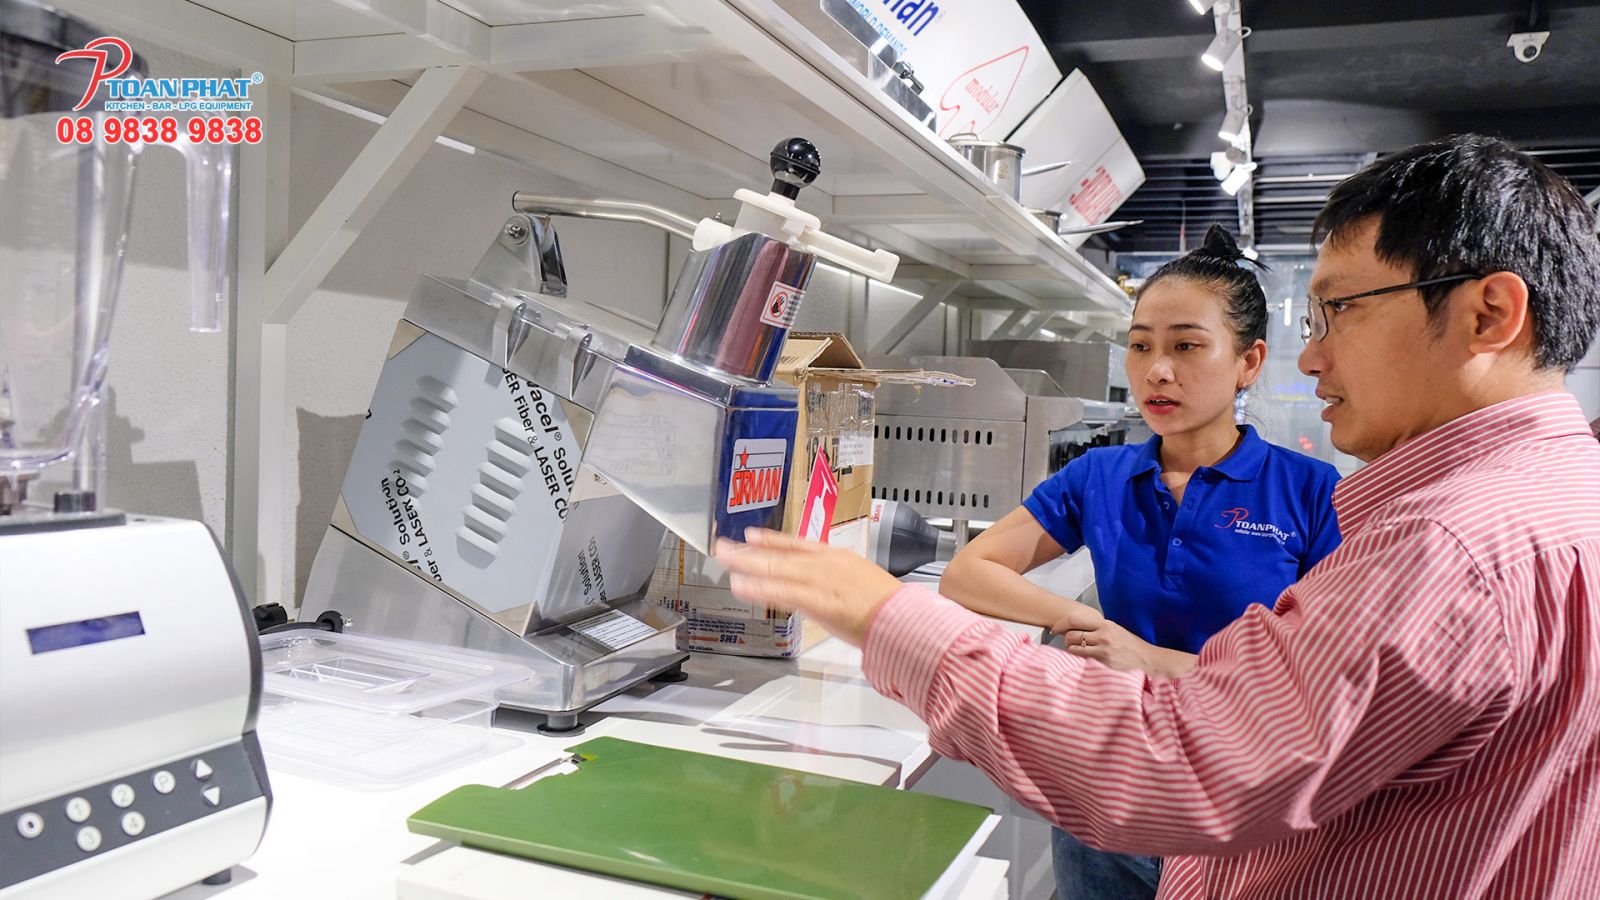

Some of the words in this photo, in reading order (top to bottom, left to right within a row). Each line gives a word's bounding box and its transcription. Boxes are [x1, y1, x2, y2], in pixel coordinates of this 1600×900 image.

[514, 395, 535, 432] Fiber
[527, 435, 538, 445] &
[534, 446, 560, 496] LASER
[729, 467, 782, 507] SIRMAN
[381, 478, 410, 545] Solution
[402, 498, 428, 547] LASER
[424, 547, 432, 557] &
[578, 549, 592, 595] Solution
[591, 554, 603, 587] LASER
[719, 634, 738, 644] EMS
